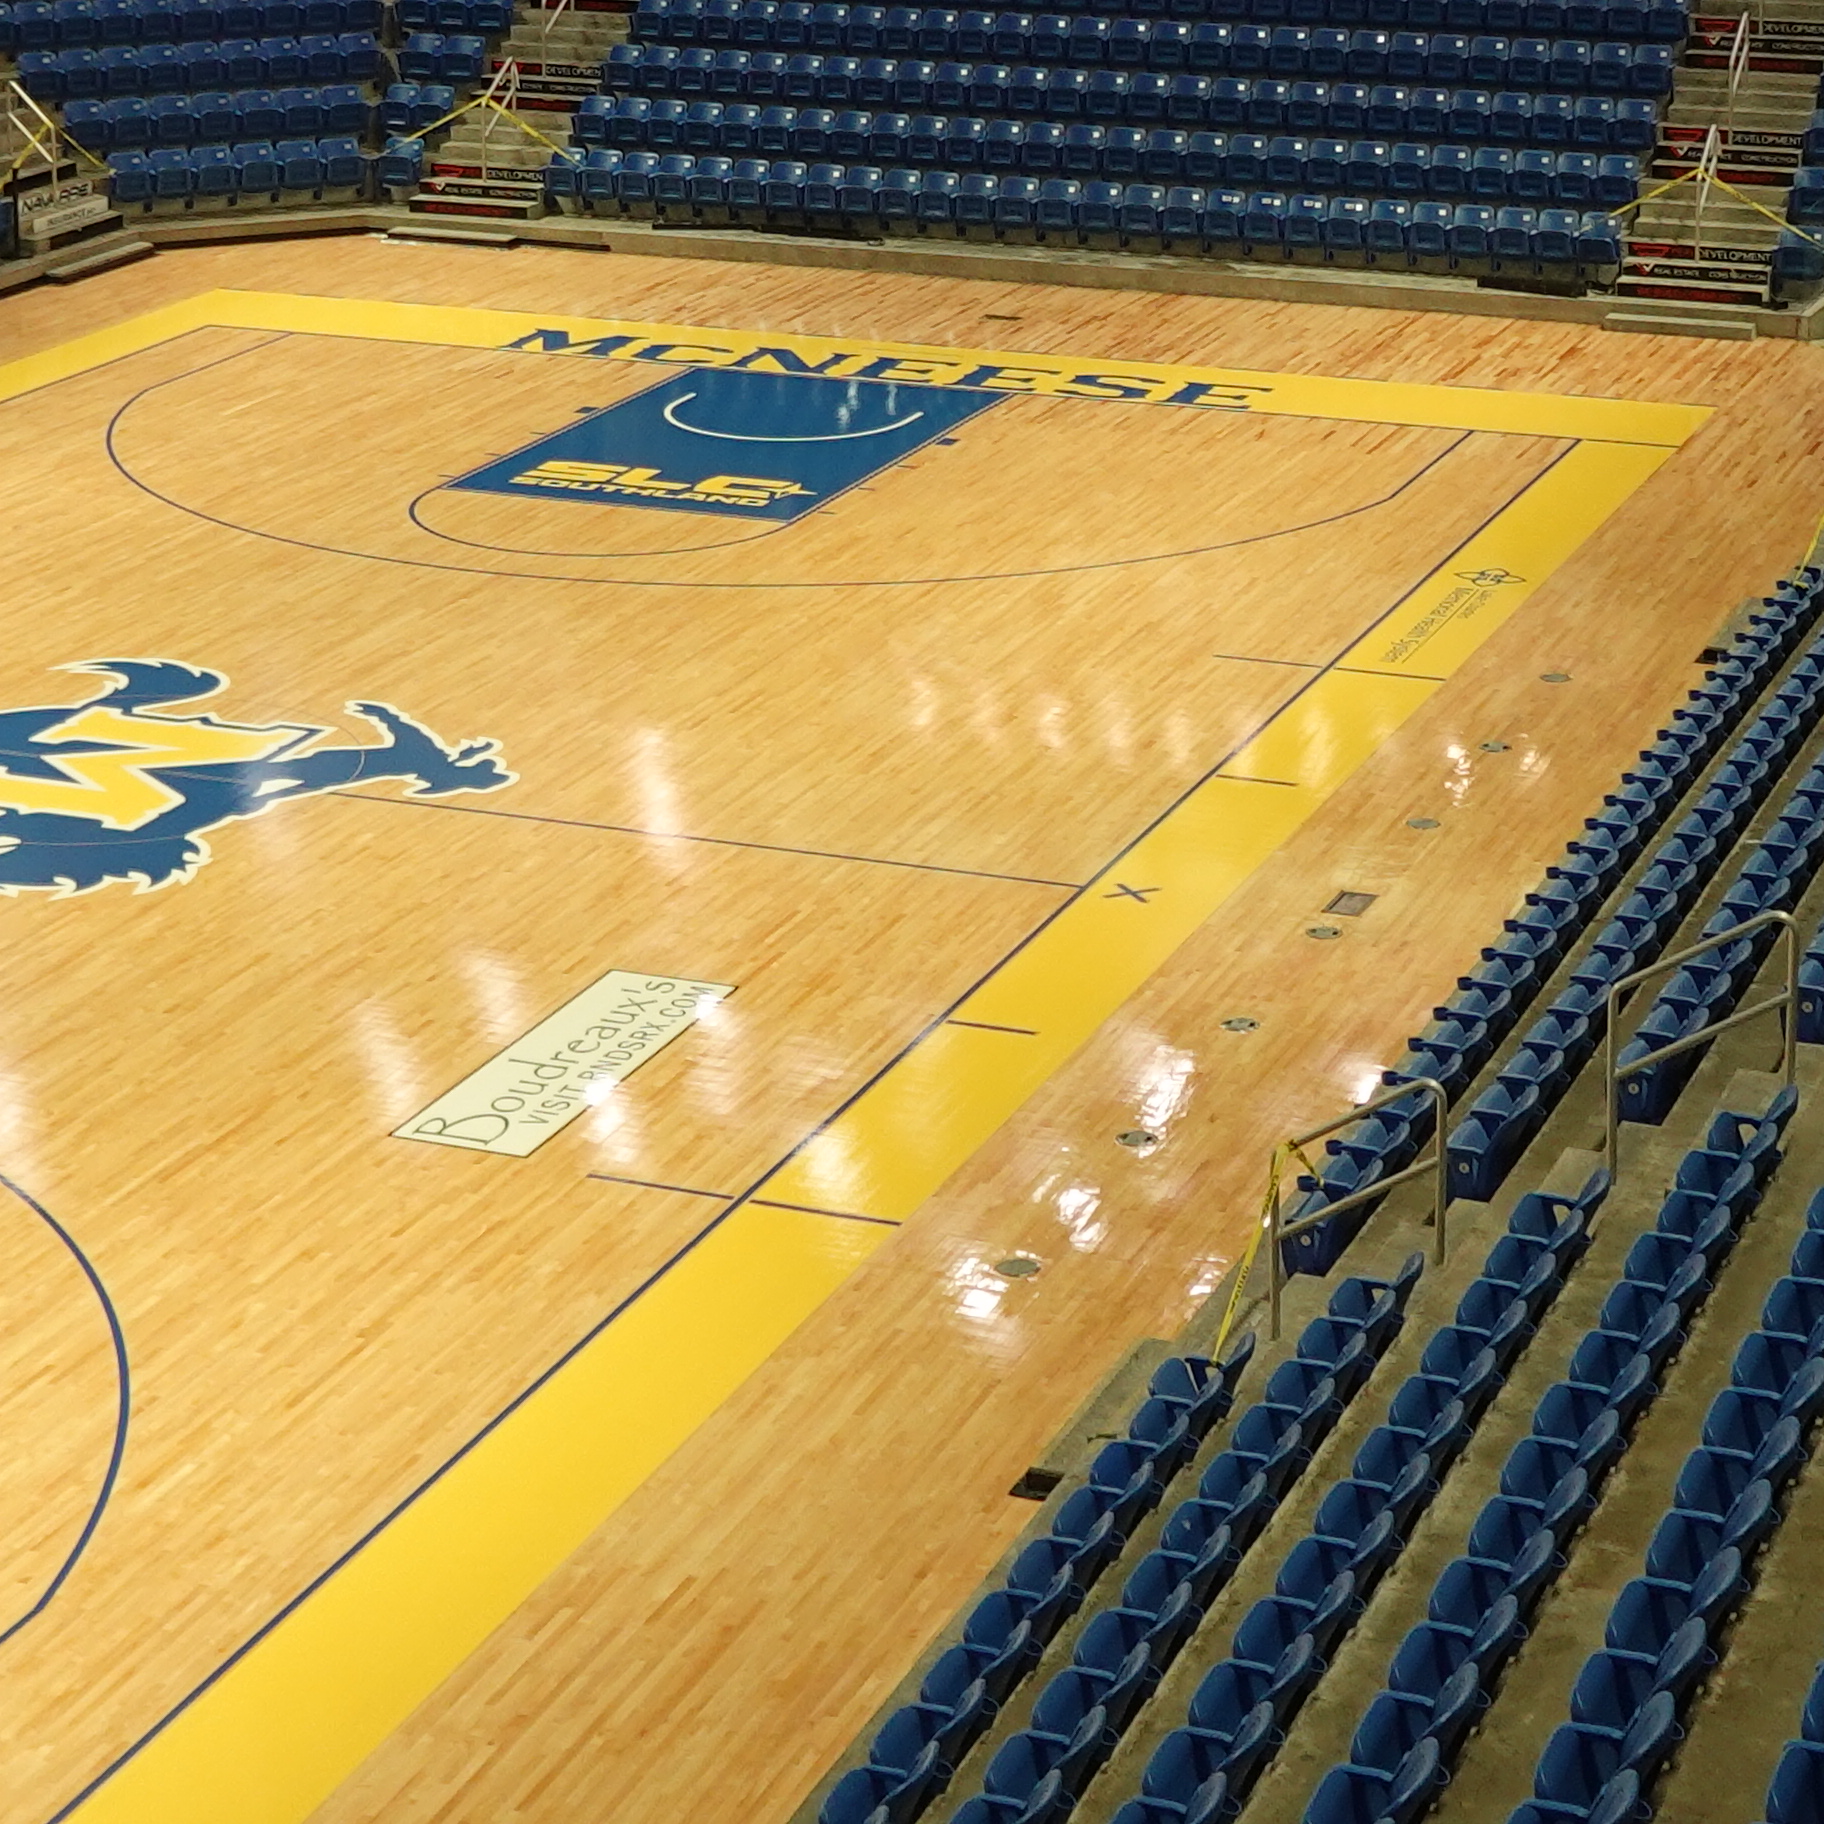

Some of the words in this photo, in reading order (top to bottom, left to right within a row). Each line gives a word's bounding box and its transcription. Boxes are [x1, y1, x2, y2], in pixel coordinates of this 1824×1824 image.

[496, 328, 1276, 411] MCNEESE
[508, 476, 774, 507] SOUTHLAND
[521, 460, 803, 498] SLC
[412, 978, 677, 1147] Boudreaux's
[518, 1084, 584, 1127] VISIT
